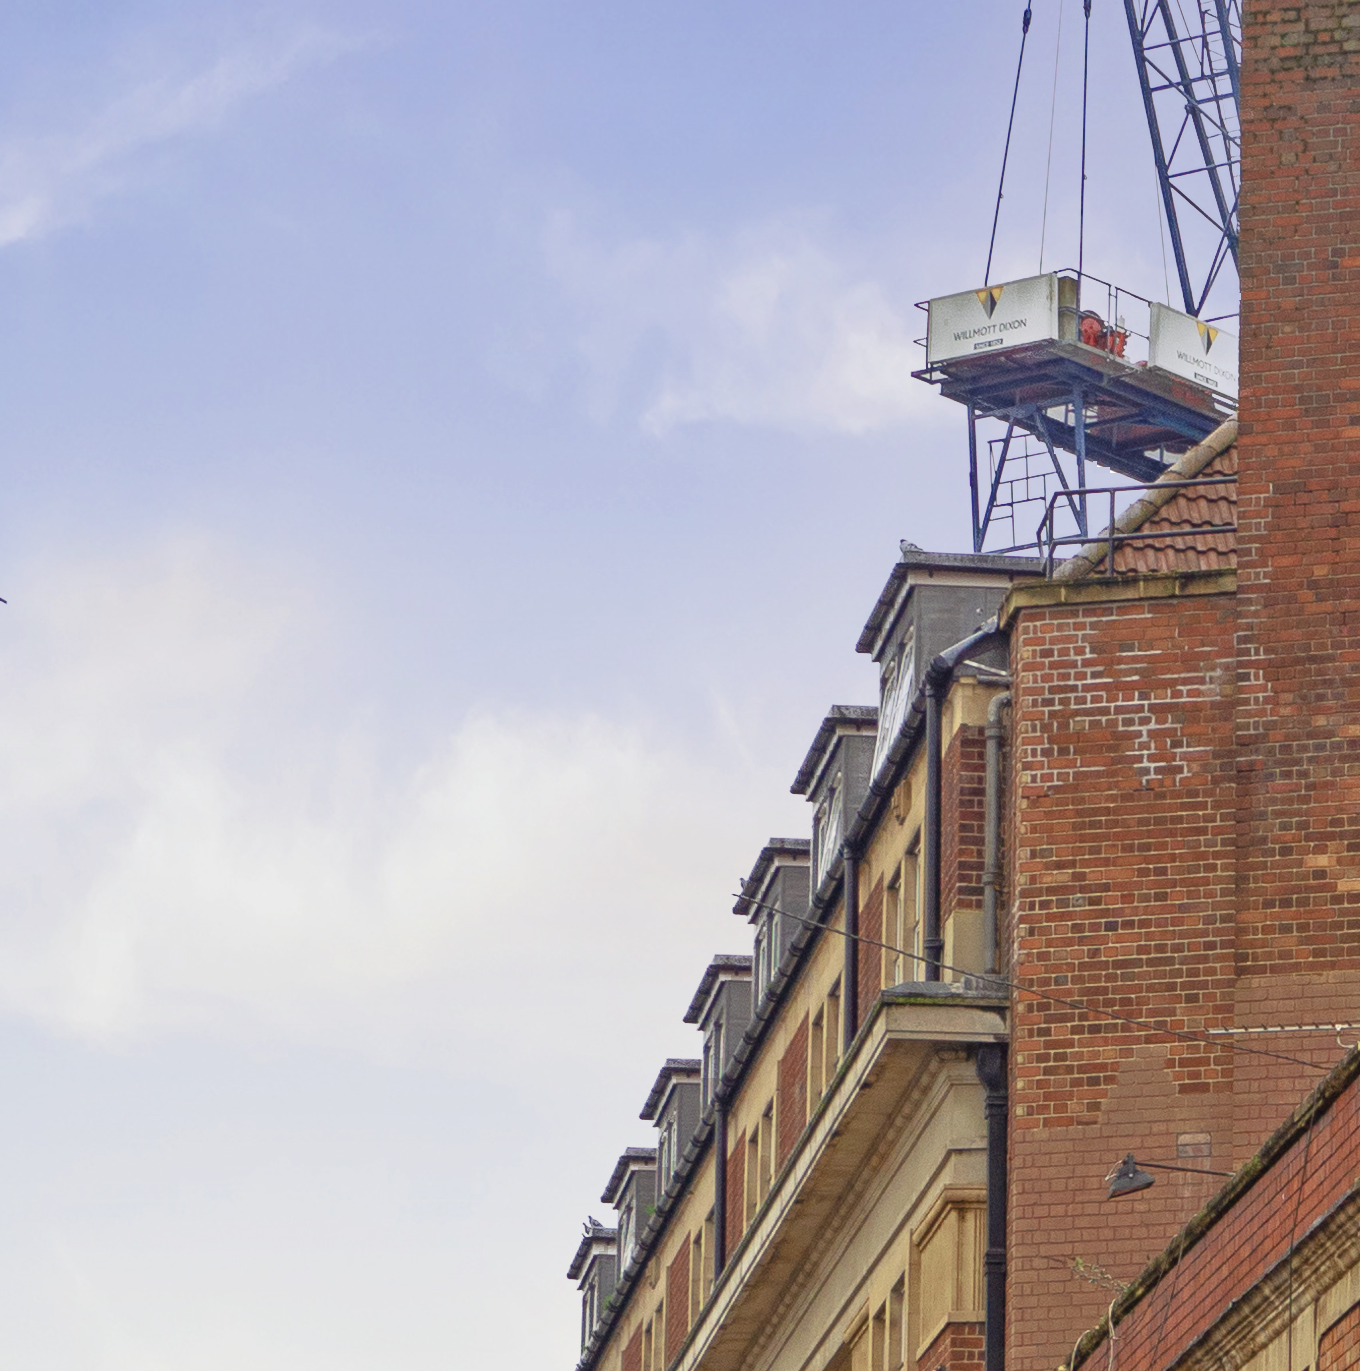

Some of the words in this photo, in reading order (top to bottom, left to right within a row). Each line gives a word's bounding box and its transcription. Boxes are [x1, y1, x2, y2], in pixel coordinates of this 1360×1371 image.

[953, 324, 997, 341] WILLMOTT
[999, 318, 1027, 332] DIXON
[1176, 350, 1212, 372] WILLMOTT
